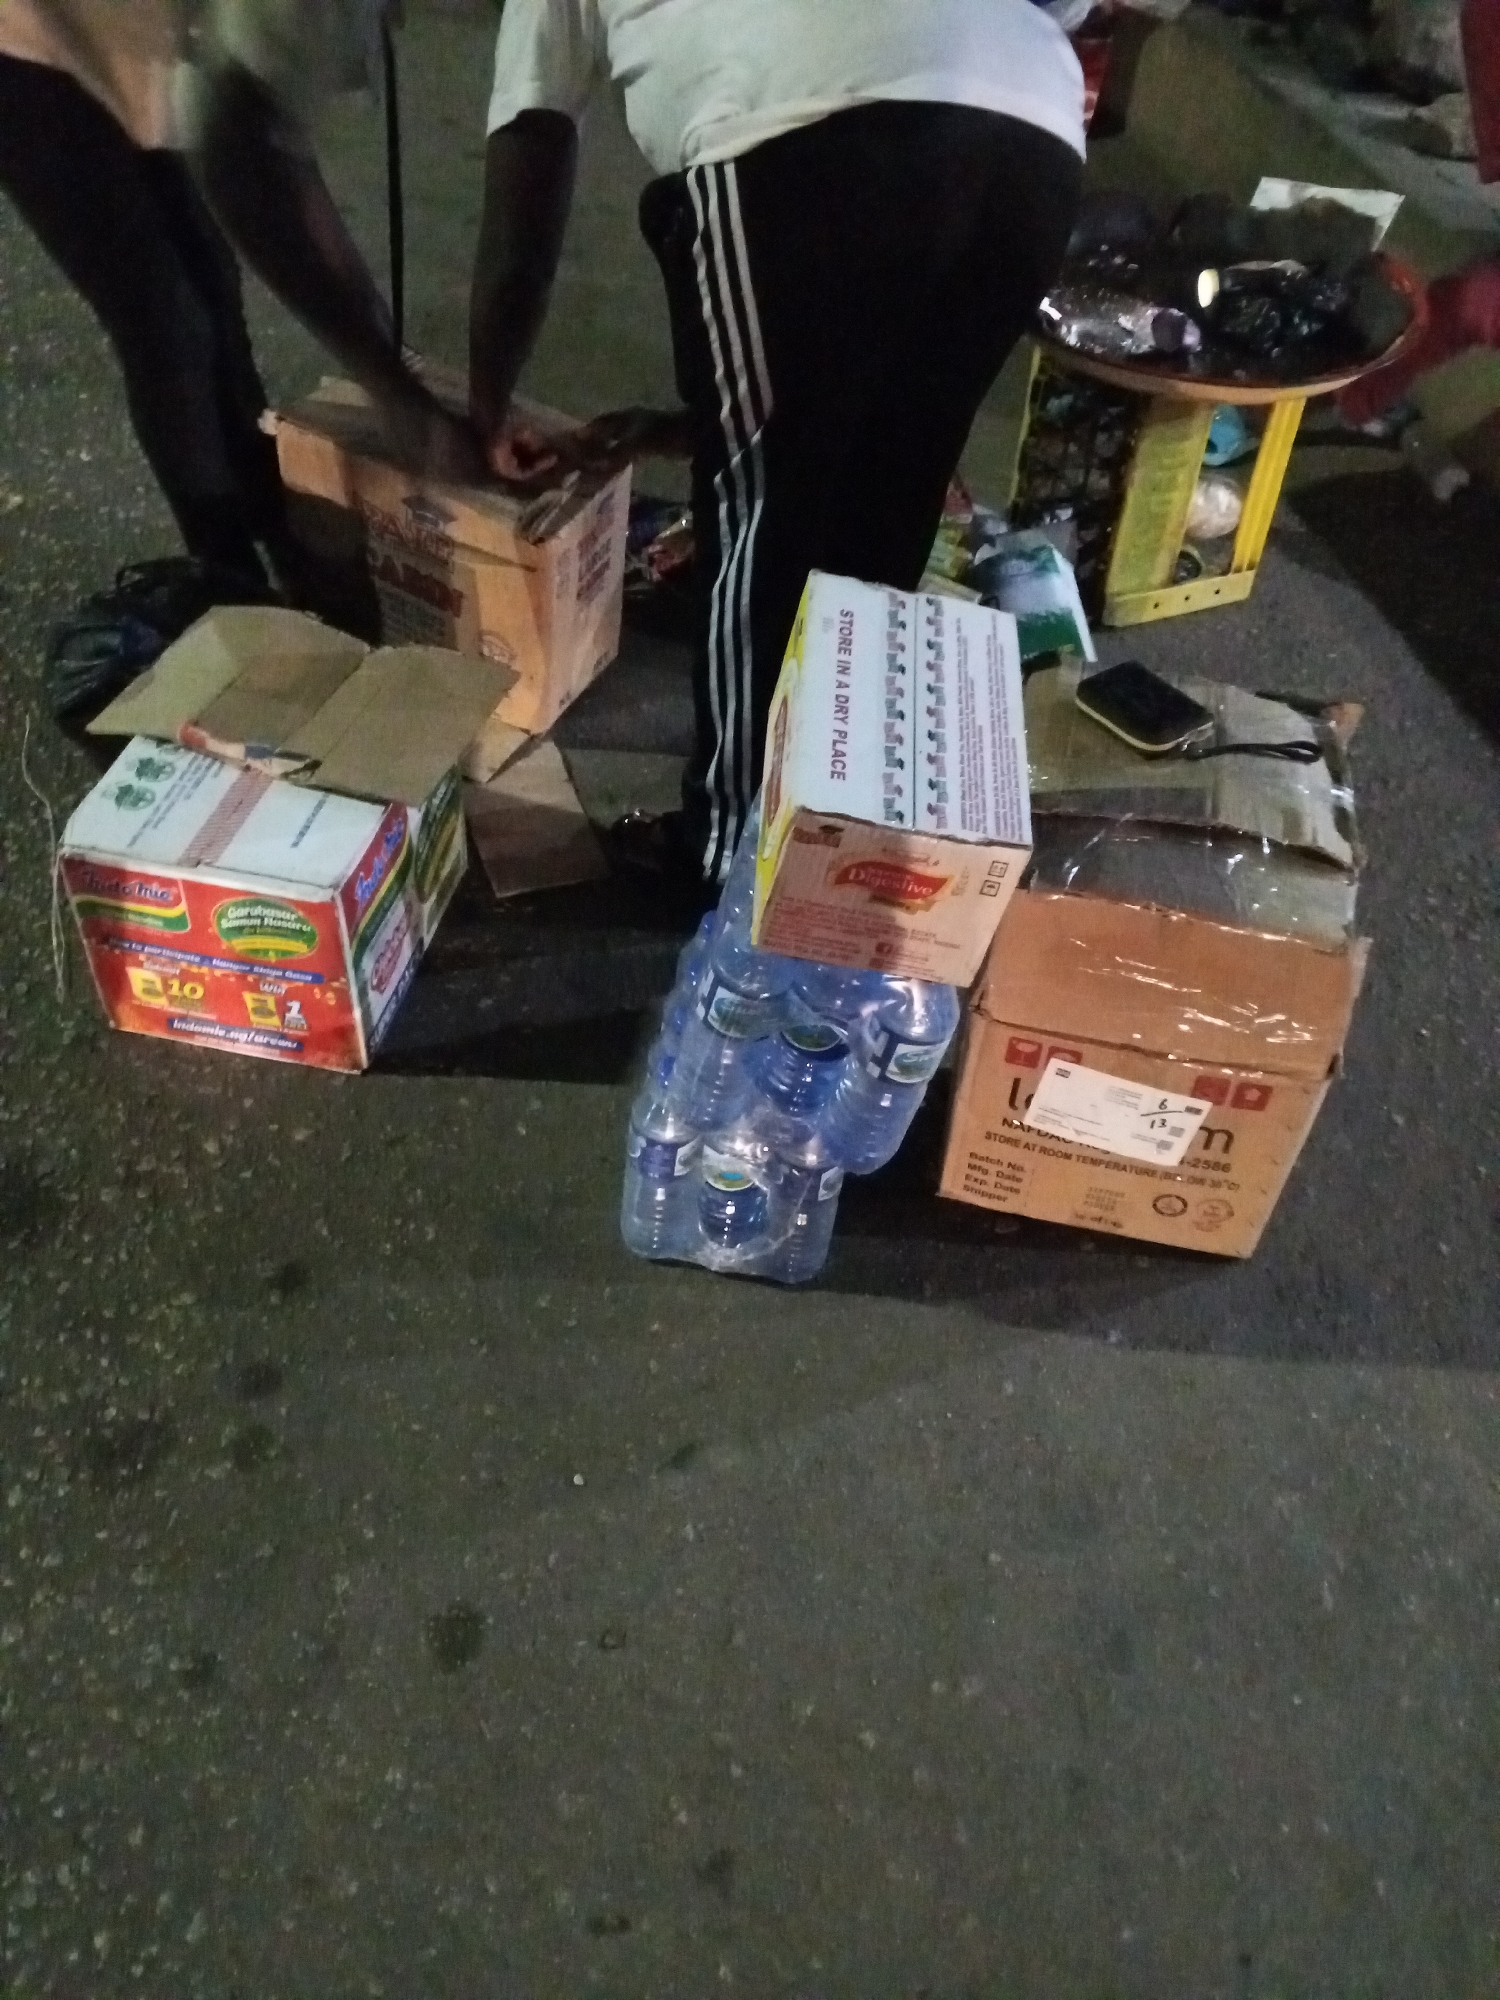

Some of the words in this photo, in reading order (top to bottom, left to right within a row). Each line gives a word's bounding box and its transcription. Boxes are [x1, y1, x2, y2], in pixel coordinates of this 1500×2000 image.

[838, 608, 854, 657] STORE
[836, 659, 851, 676] IN
[835, 679, 850, 689] A
[833, 694, 849, 726] DRY
[830, 728, 848, 782] PLACE
[848, 867, 933, 896] Digestive
[167, 978, 205, 1000] 10
[1158, 1098, 1169, 1110] 6
[1149, 1118, 1168, 1130] 13
[969, 1151, 1004, 1167] Batch
[984, 1130, 1022, 1149] STORE
[1022, 1142, 1038, 1152] AT
[1038, 1145, 1073, 1161] ROOM
[1076, 1153, 1158, 1178] TEMPERATURE
[995, 1170, 1023, 1184] Date
[993, 1181, 1021, 1195] Date
